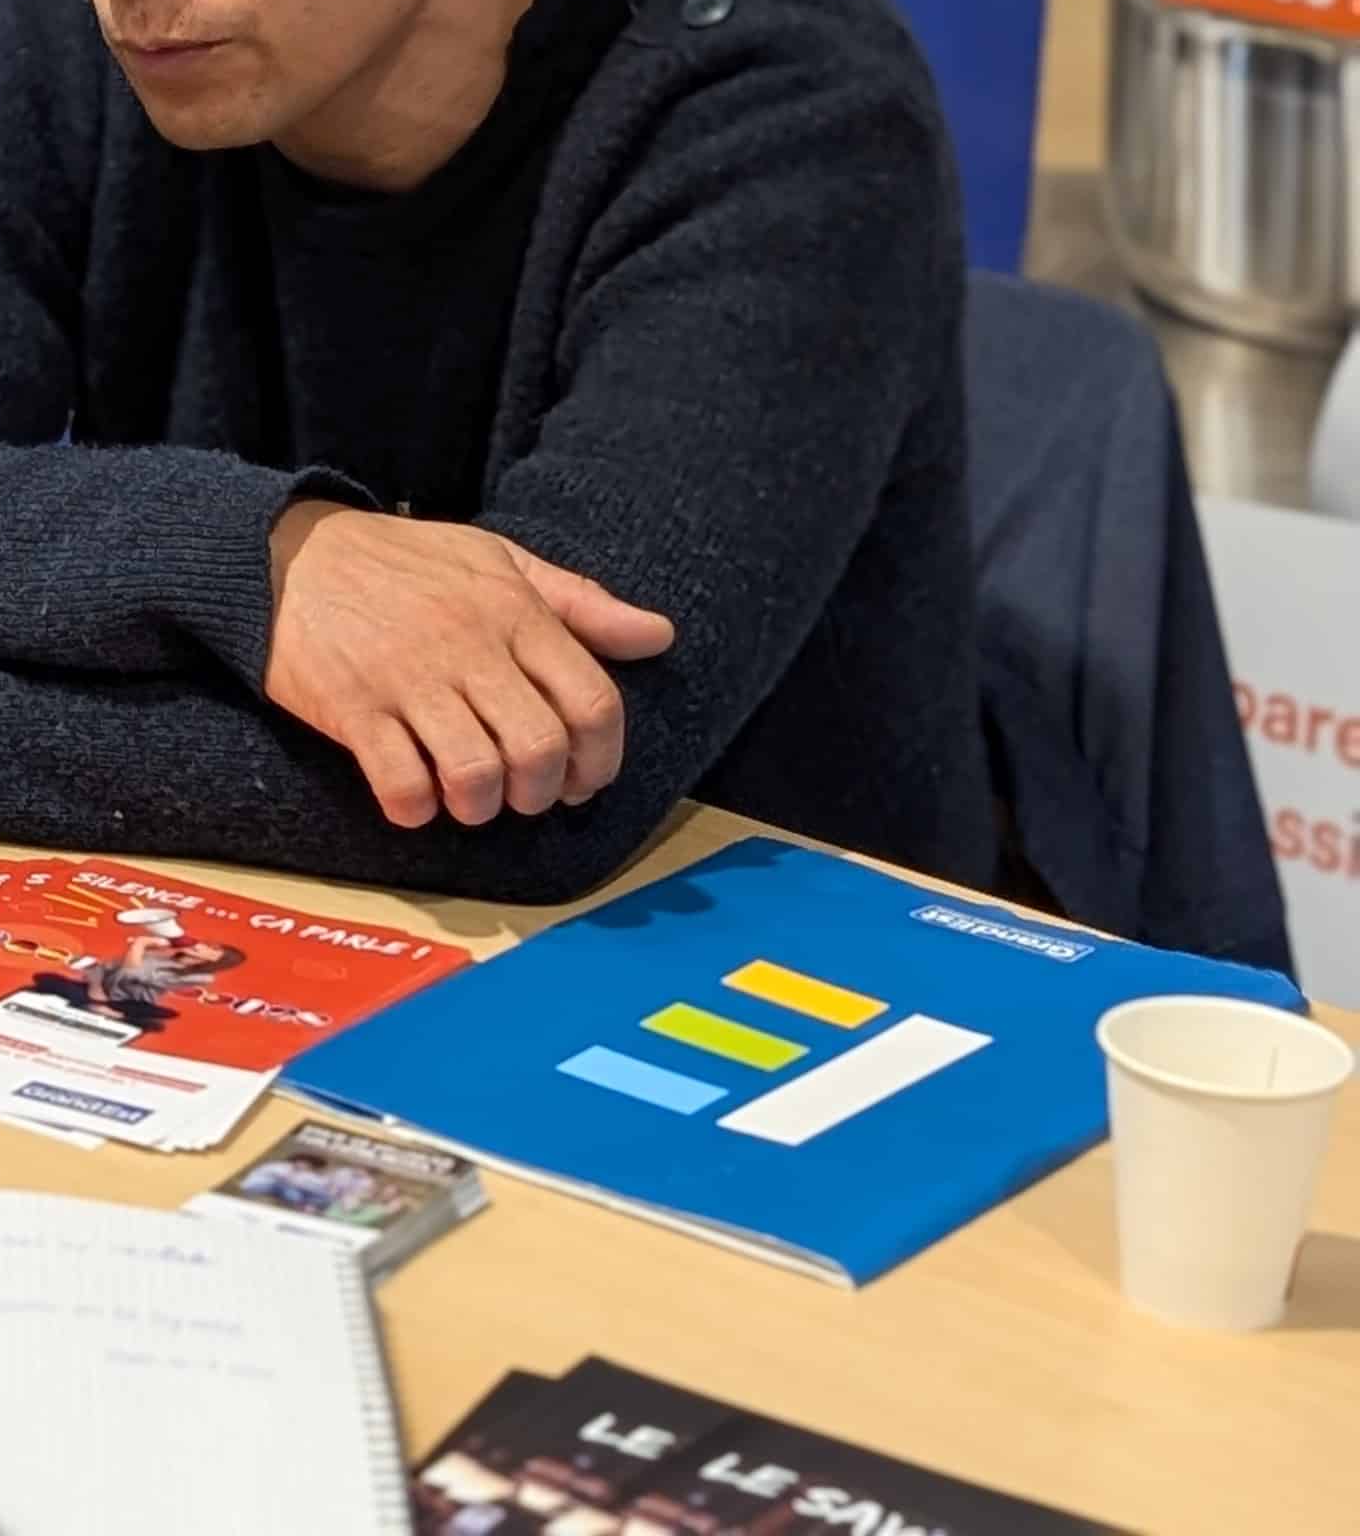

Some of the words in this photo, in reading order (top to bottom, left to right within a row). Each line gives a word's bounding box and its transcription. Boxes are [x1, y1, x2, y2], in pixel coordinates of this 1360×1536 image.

[72, 872, 205, 909] SILENCE
[298, 924, 413, 956] PARLE
[577, 1410, 678, 1462] LE
[697, 1452, 800, 1499] LE
